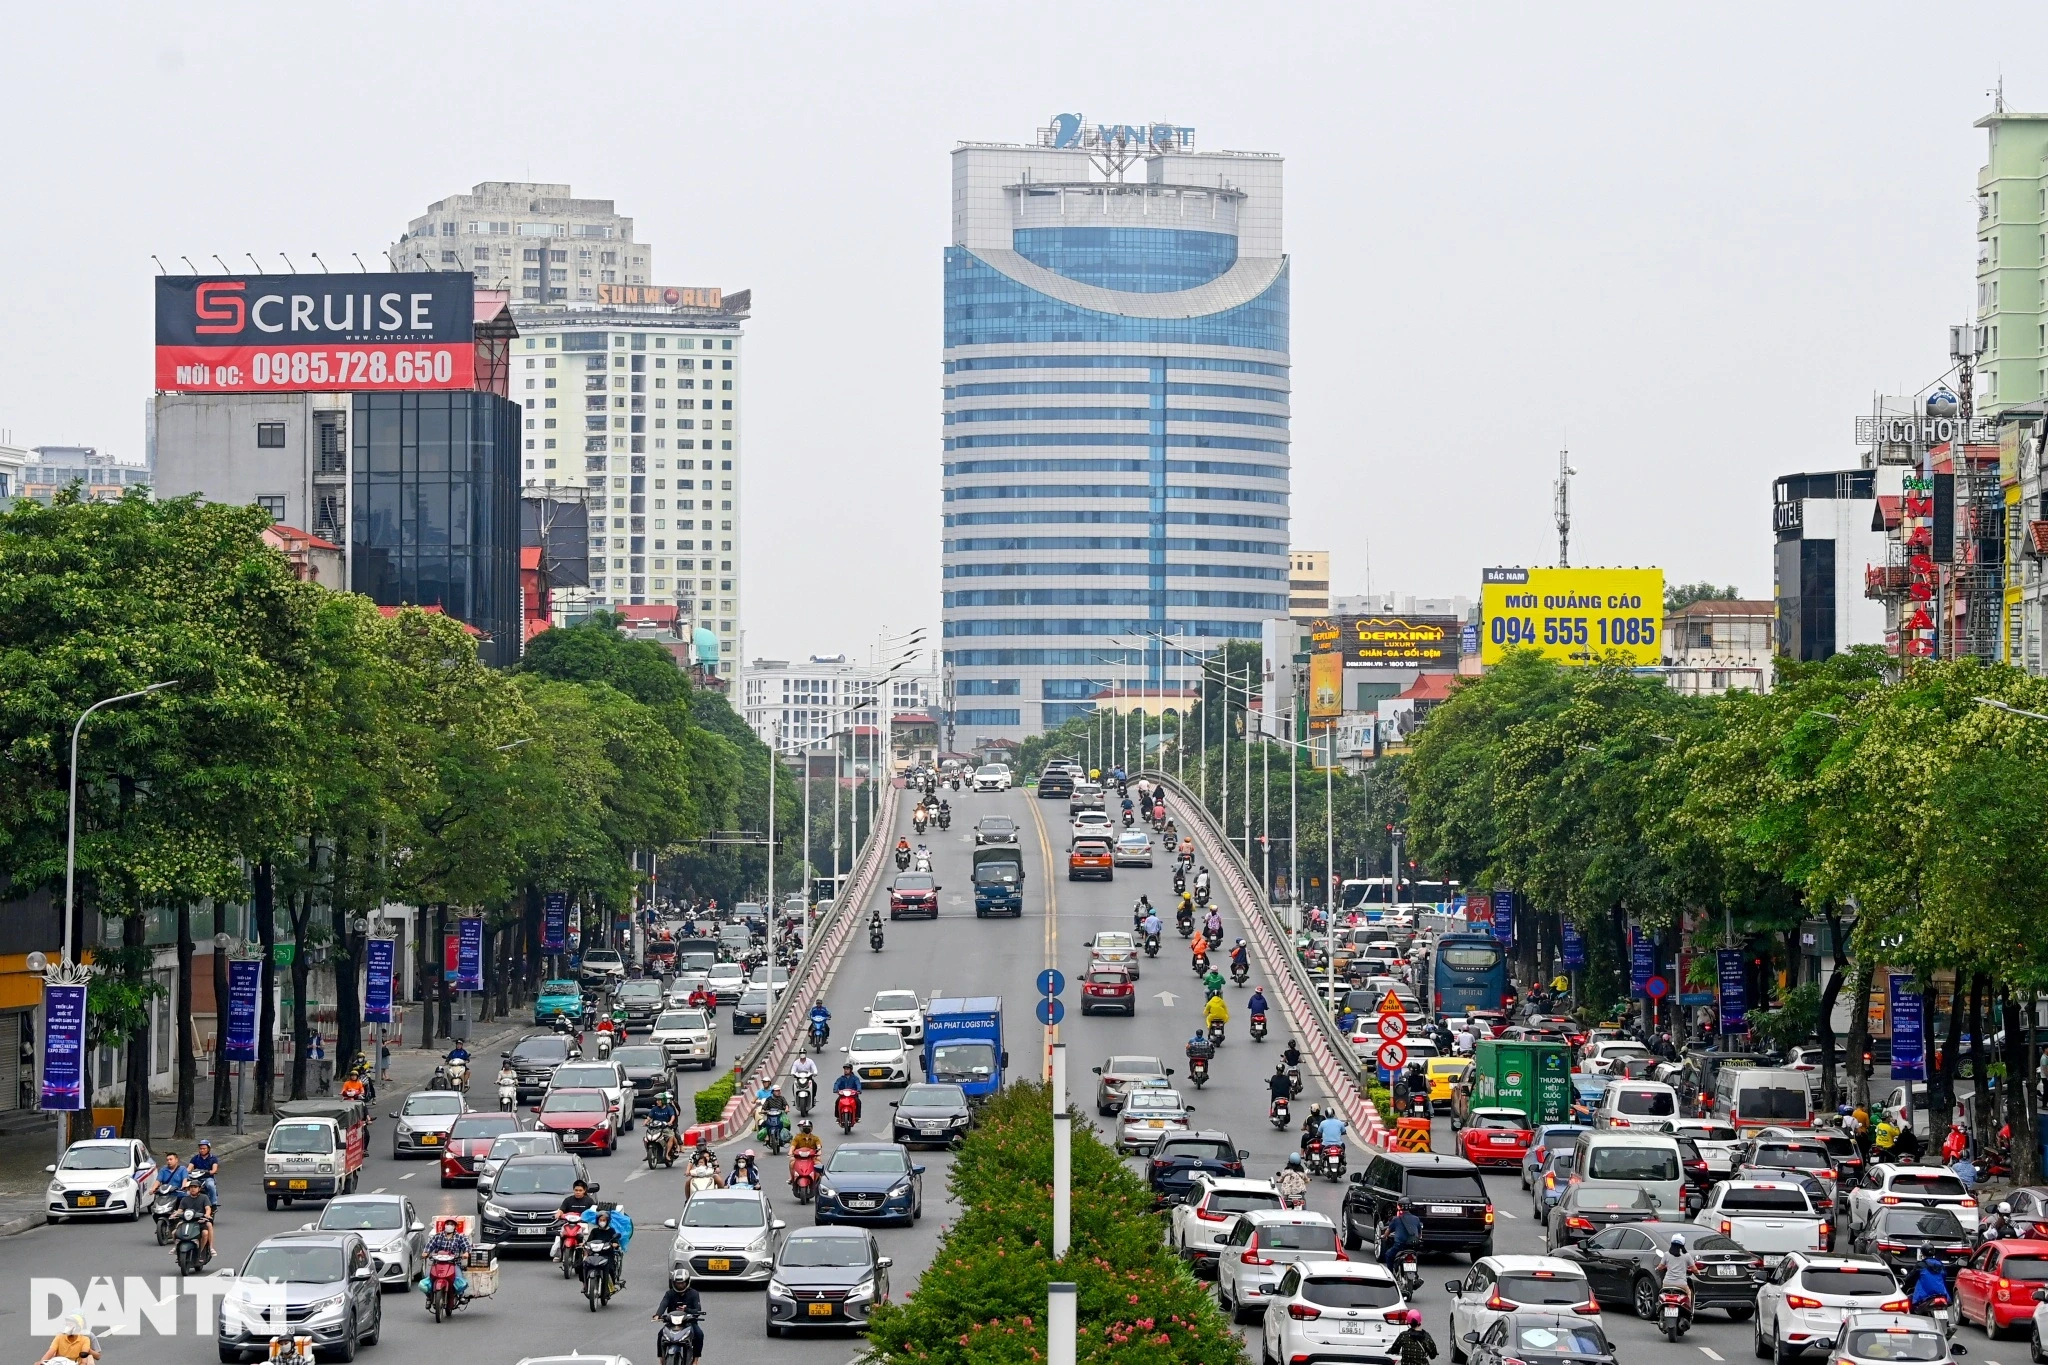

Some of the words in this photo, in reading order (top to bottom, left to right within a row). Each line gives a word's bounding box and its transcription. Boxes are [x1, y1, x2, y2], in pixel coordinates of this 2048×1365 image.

[1098, 124, 1195, 146] VNPT
[598, 285, 638, 304] SUN
[176, 363, 210, 385] MỜI
[215, 366, 243, 386] QC:
[252, 350, 452, 385] 0985.728.650
[1921, 418, 1996, 442] HOTEL
[1506, 572, 1525, 581] NAM
[1905, 497, 1936, 657] MASSAG
[1505, 592, 1538, 608] MỜI
[1544, 590, 1601, 610] QUẢNG
[1607, 593, 1641, 608] CÁO
[1359, 632, 1441, 640] DEMXINH
[1491, 617, 1536, 644] 094
[1544, 617, 1588, 645] 555
[1597, 617, 1655, 645] 1085
[100, 1128, 110, 1137] G7
